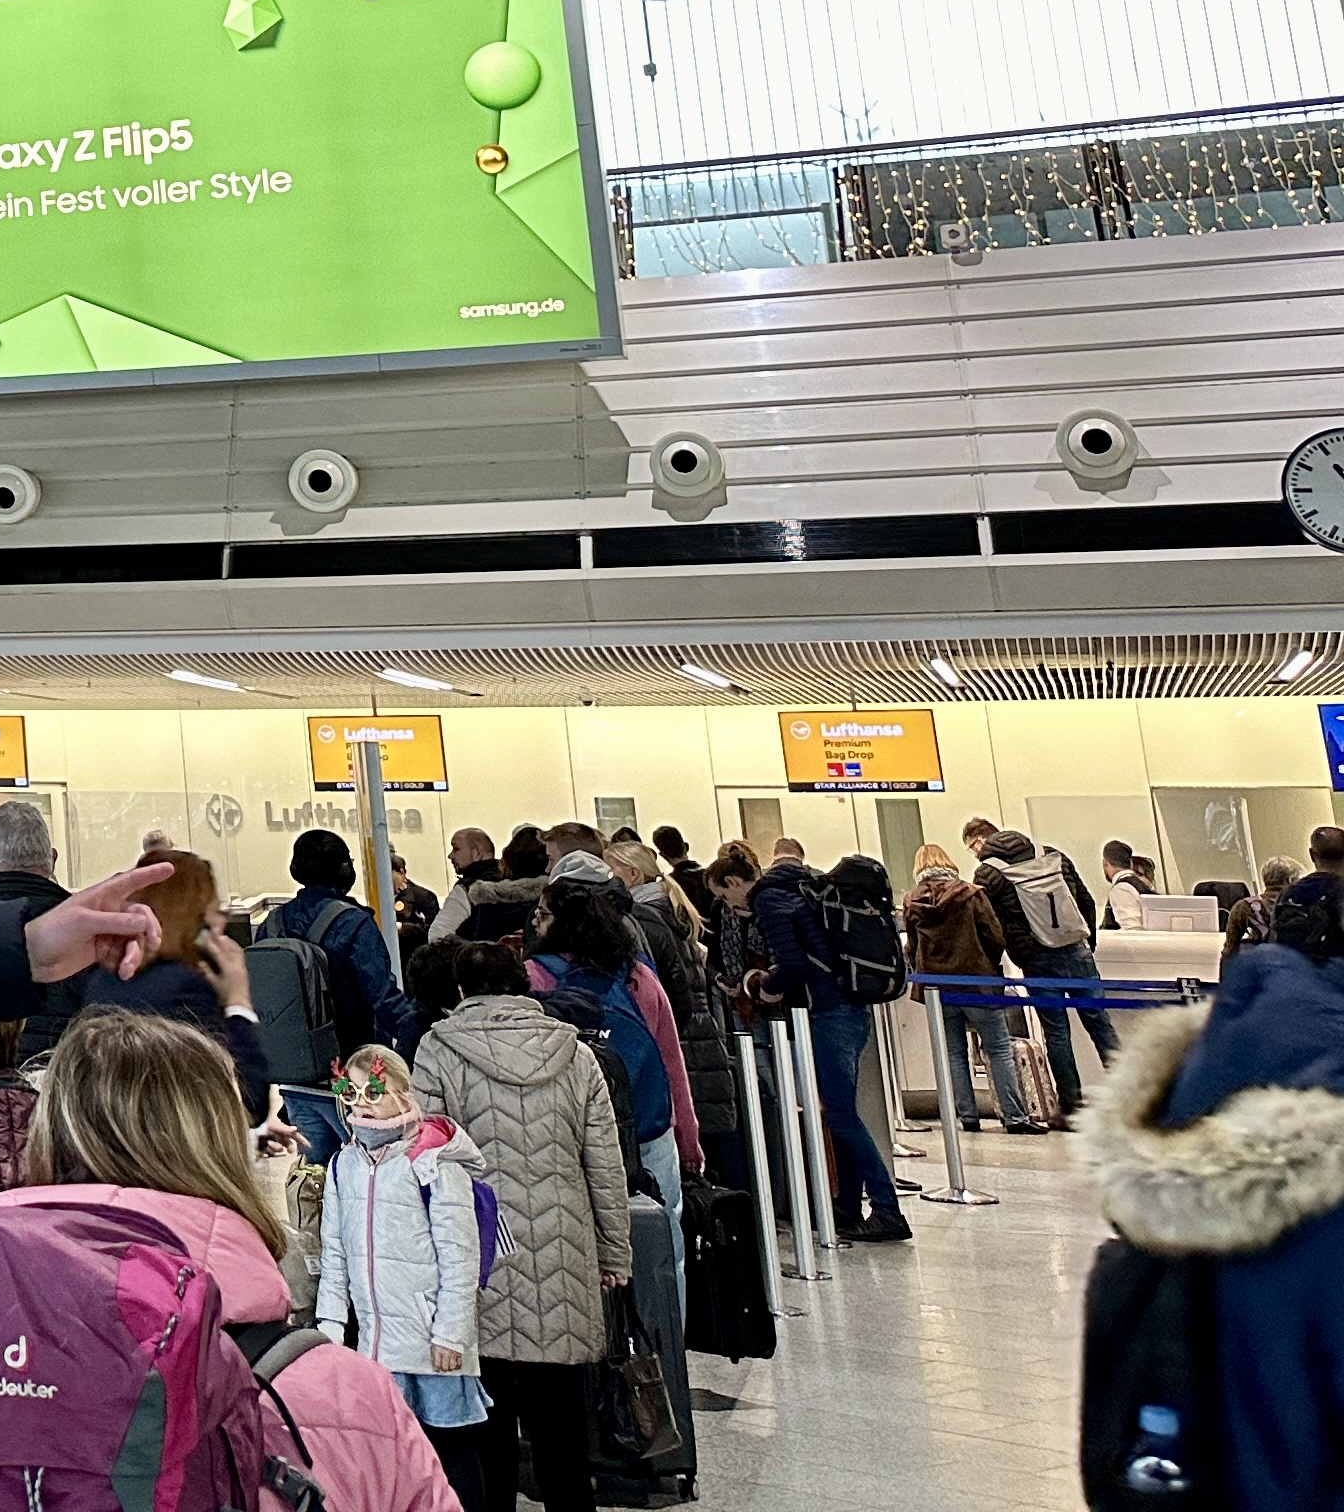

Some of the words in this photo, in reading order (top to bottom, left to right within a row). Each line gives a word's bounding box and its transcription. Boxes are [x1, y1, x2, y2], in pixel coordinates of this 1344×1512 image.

[73, 129, 97, 162] Z
[102, 119, 194, 165] Flip5
[40, 185, 107, 216] Fest
[112, 179, 203, 208] voller
[210, 168, 293, 204] Style
[459, 297, 565, 319] samsung.de
[343, 727, 415, 740] Lufthansa
[820, 722, 903, 737] Lufthansa
[823, 738, 872, 748] Premium
[825, 750, 846, 761] Bag
[847, 750, 875, 761] Drop
[814, 782, 836, 790] STAR
[264, 800, 423, 832] Lufthasa
